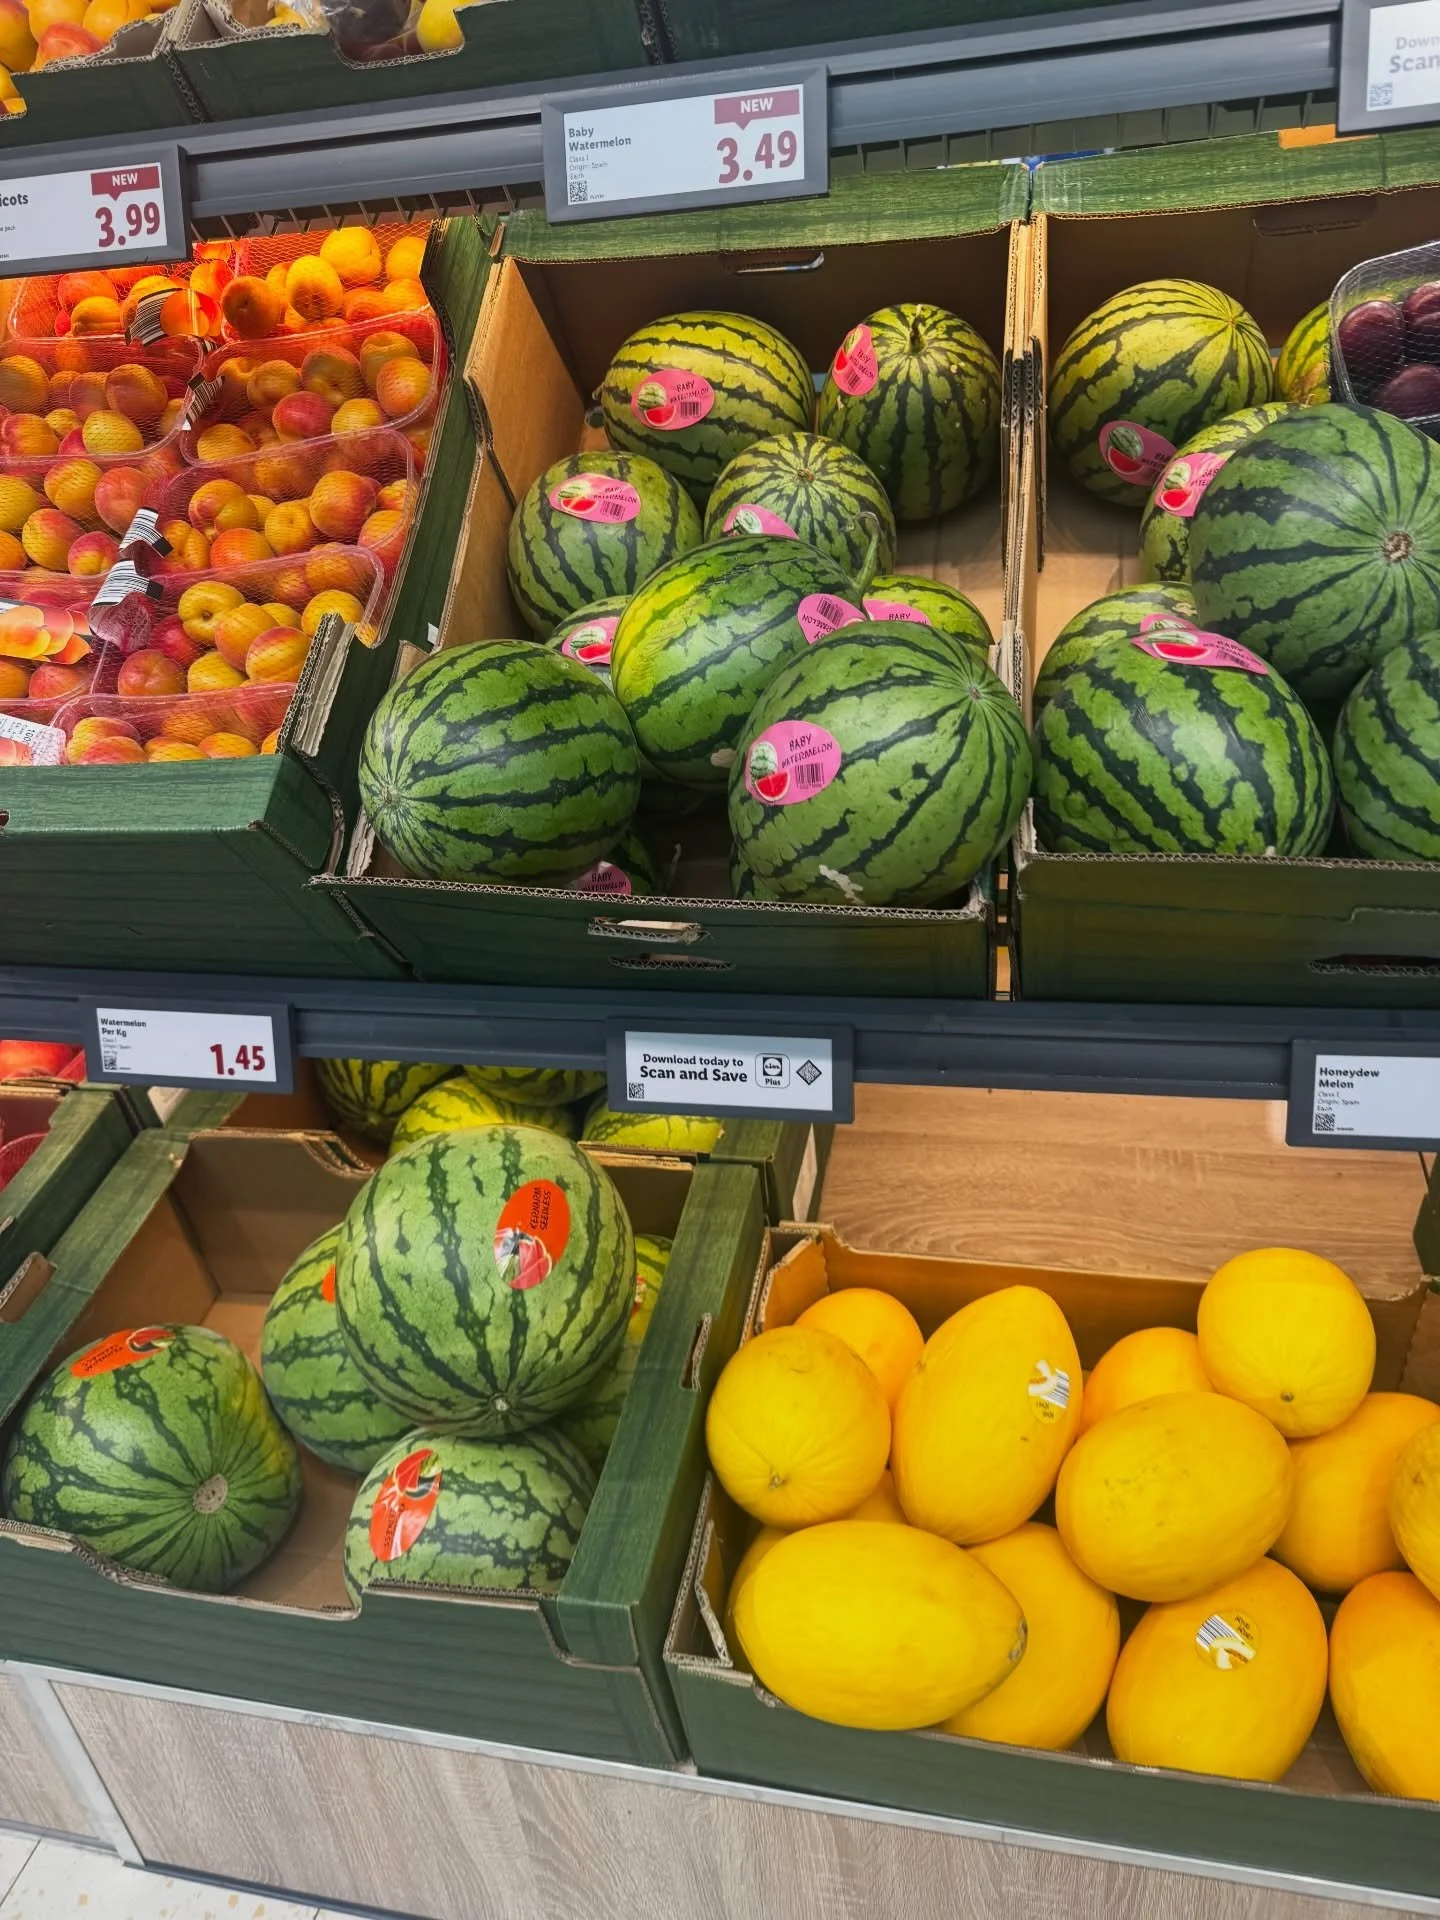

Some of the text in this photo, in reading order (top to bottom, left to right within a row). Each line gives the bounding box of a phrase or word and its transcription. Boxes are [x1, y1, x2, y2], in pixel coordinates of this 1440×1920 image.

[1396, 36, 1440, 49] Down
[740, 97, 774, 114] NEW
[568, 126, 594, 138] Baby
[569, 136, 632, 152] Watermelon
[716, 130, 797, 184] 3.49
[112, 172, 138, 187] NEW
[0, 193, 29, 207] icots
[95, 201, 160, 248] 3.99
[676, 380, 695, 393] BABY
[789, 733, 812, 752] BABY
[781, 741, 833, 769] WATERMELON
[591, 871, 613, 883] BABY
[100, 1018, 147, 1028] Watermelon
[102, 1027, 127, 1038] Per Kg
[210, 1044, 266, 1076] 1.45
[643, 1054, 744, 1068] Download today to
[640, 1065, 748, 1082] Scan and Save
[1320, 1067, 1380, 1078] Honeydew
[765, 1078, 781, 1086] Plus
[1319, 1079, 1354, 1088] Melon
